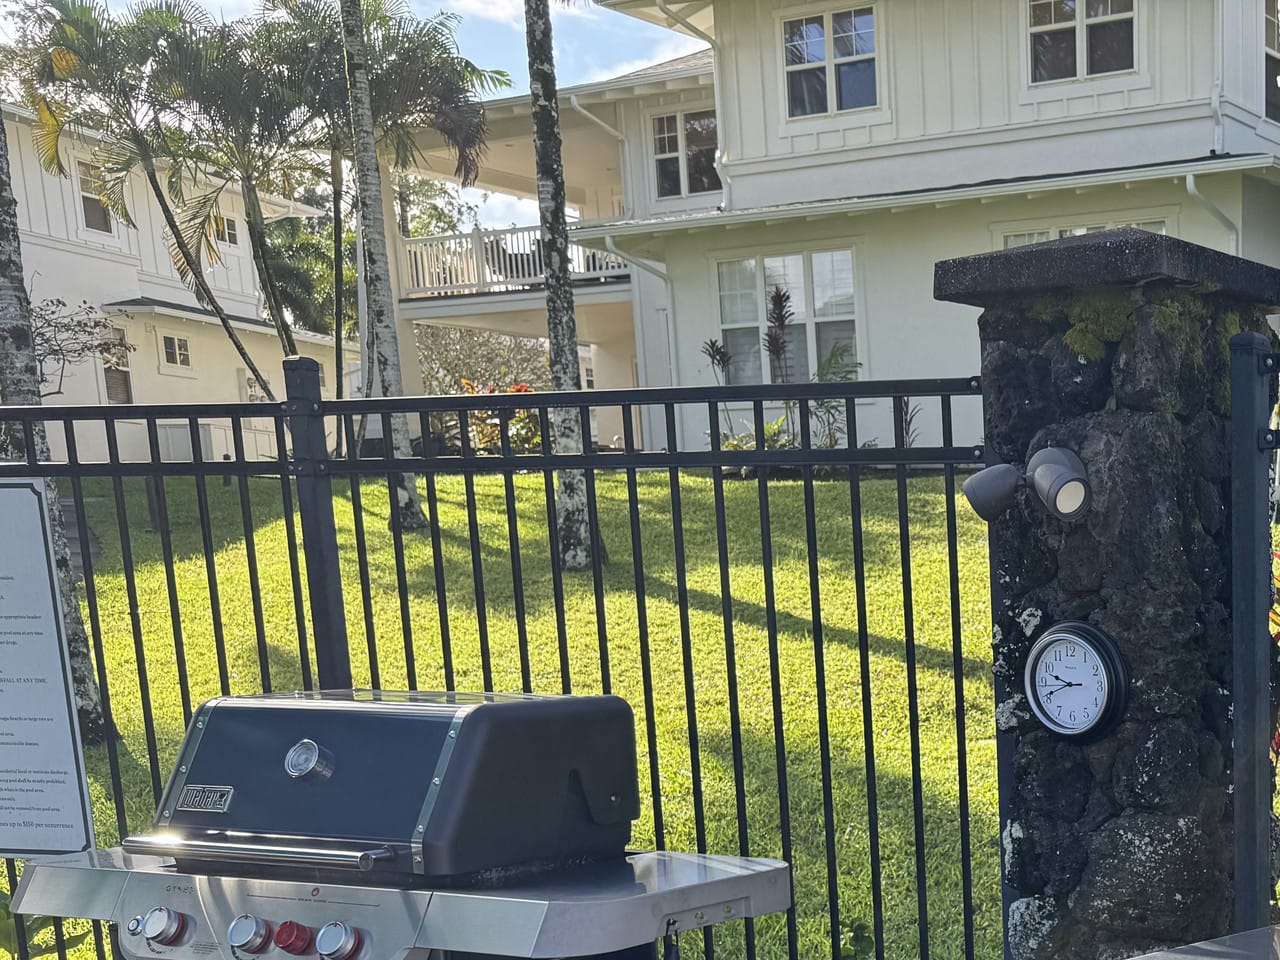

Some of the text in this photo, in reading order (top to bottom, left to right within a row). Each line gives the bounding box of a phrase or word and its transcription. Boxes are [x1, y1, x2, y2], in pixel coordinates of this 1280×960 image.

[1054, 650, 1062, 662] 11
[1065, 645, 1076, 657] 12
[1083, 651, 1087, 663] 1
[1045, 662, 1054, 673] 10
[1092, 665, 1099, 676] 2
[1041, 677, 1047, 687] 9
[1097, 681, 1103, 693] 3
[1045, 694, 1052, 704] 8
[1093, 697, 1098, 708] 4
[1056, 705, 1062, 717] 7
[1069, 711, 1076, 722] 6
[1083, 708, 1089, 719] 5
[184, 788, 219, 808] weber
